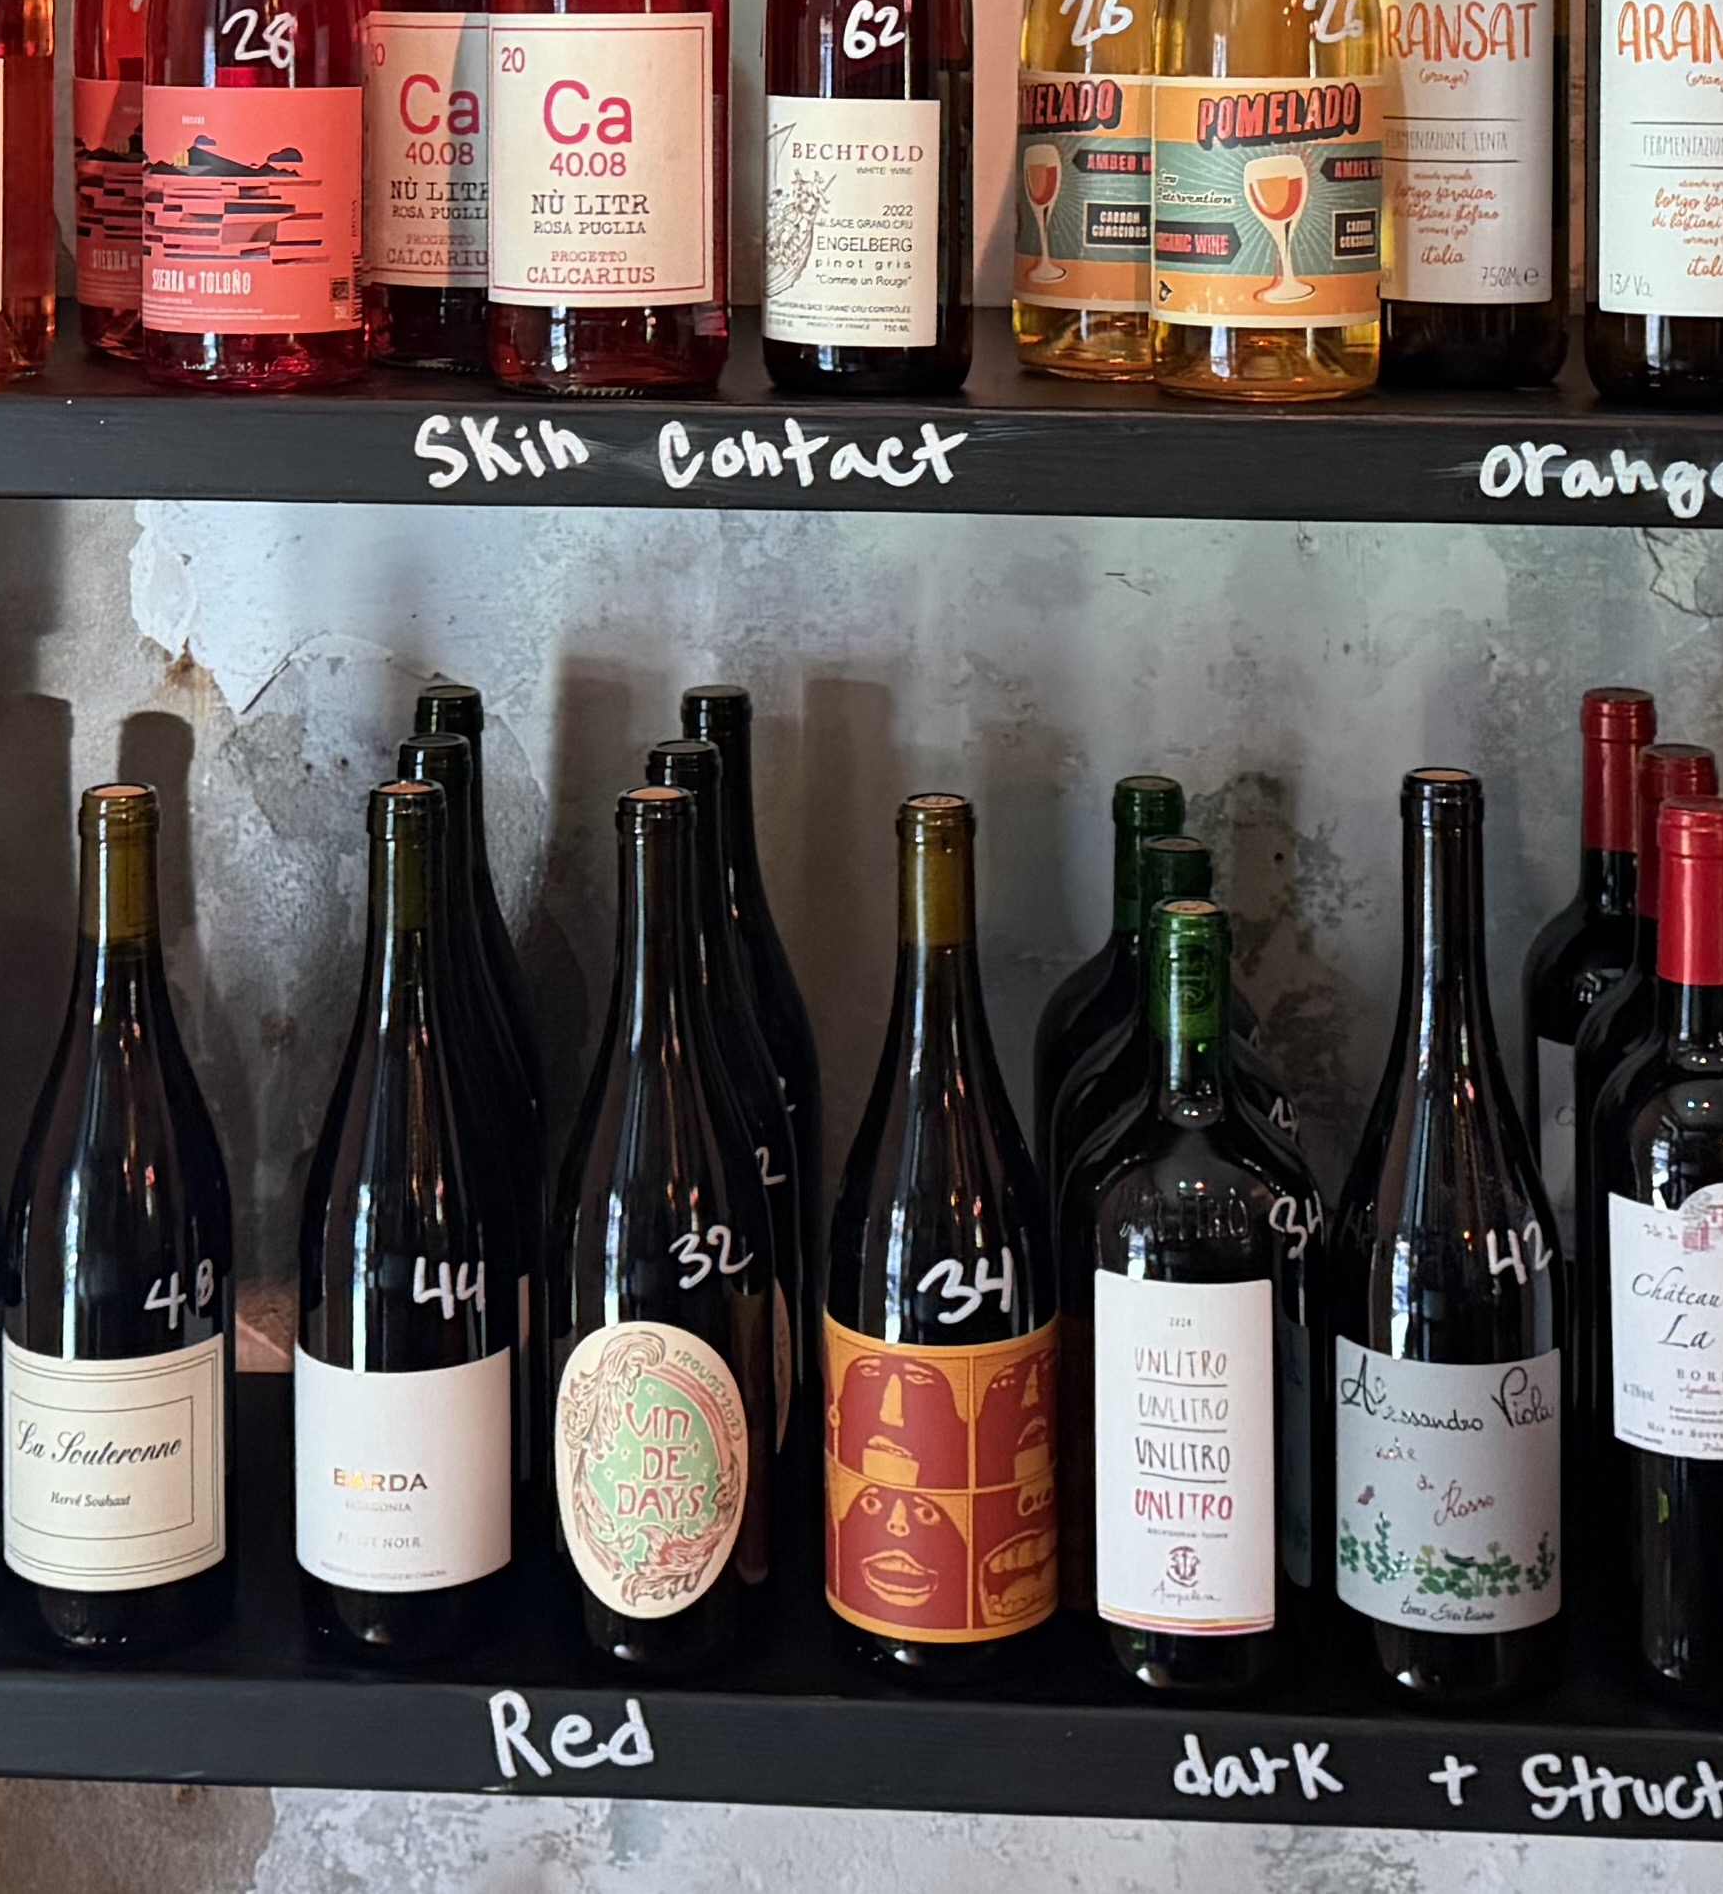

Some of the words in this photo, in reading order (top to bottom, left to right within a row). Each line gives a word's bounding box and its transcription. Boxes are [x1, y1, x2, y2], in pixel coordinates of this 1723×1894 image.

[220, 8, 298, 69] 28
[842, 0, 907, 60] 62
[500, 46, 526, 74] 20
[398, 73, 480, 136] Ca
[542, 79, 633, 145] Ca
[1197, 81, 1363, 150] POMELADO
[405, 141, 475, 166] 40.08
[549, 151, 627, 177] 40.08
[791, 142, 925, 162] BECHTOLD
[1086, 152, 1138, 174] AMBER
[856, 166, 886, 176] WHITE
[390, 179, 418, 202] NÙ
[530, 189, 566, 216] NÙ
[574, 193, 651, 216] LITR
[1655, 188, 1700, 216] borgo
[392, 205, 425, 220] ROSA
[881, 204, 914, 217] 2022
[1099, 209, 1141, 225] CARBON
[1652, 212, 1666, 228] di
[534, 220, 573, 235] ROSA
[578, 220, 647, 235] PUGLIA
[857, 219, 891, 229] GRAND
[892, 220, 914, 230] CRU
[1092, 225, 1148, 239] CONSCIOUS
[406, 234, 476, 246] PROGETTO
[816, 235, 914, 253] ENGELBERG
[1194, 234, 1230, 256] WINE
[550, 250, 628, 263] PROGETTO
[815, 258, 865, 270] pinot
[875, 259, 913, 271] gris
[1420, 243, 1466, 265] italia
[152, 268, 185, 293] SIERRA
[199, 268, 252, 295] TOLOÑO
[526, 266, 656, 285] CALCARIUS
[860, 277, 873, 286] un
[415, 415, 590, 489] Skin
[659, 419, 968, 490] Contact
[668, 1224, 755, 1291] 32
[1486, 1220, 1554, 1286] 42
[143, 1257, 216, 1331] 48
[413, 1255, 485, 1320] 44
[917, 1247, 1014, 1324] 34
[1657, 1313, 1718, 1350] La
[1134, 1345, 1228, 1379] UNLITRO
[1138, 1391, 1229, 1423] UNLITRO
[1490, 1365, 1555, 1430] Viola
[16, 1419, 47, 1459] La
[50, 1430, 183, 1467] Souteronne
[1134, 1436, 1231, 1474] UNLITRO
[615, 1482, 706, 1519] DAYS
[1134, 1487, 1234, 1521] UNLITRO
[490, 1691, 655, 1778] Red
[1175, 1735, 1343, 1800] dark
[1430, 1756, 1476, 1806] +
